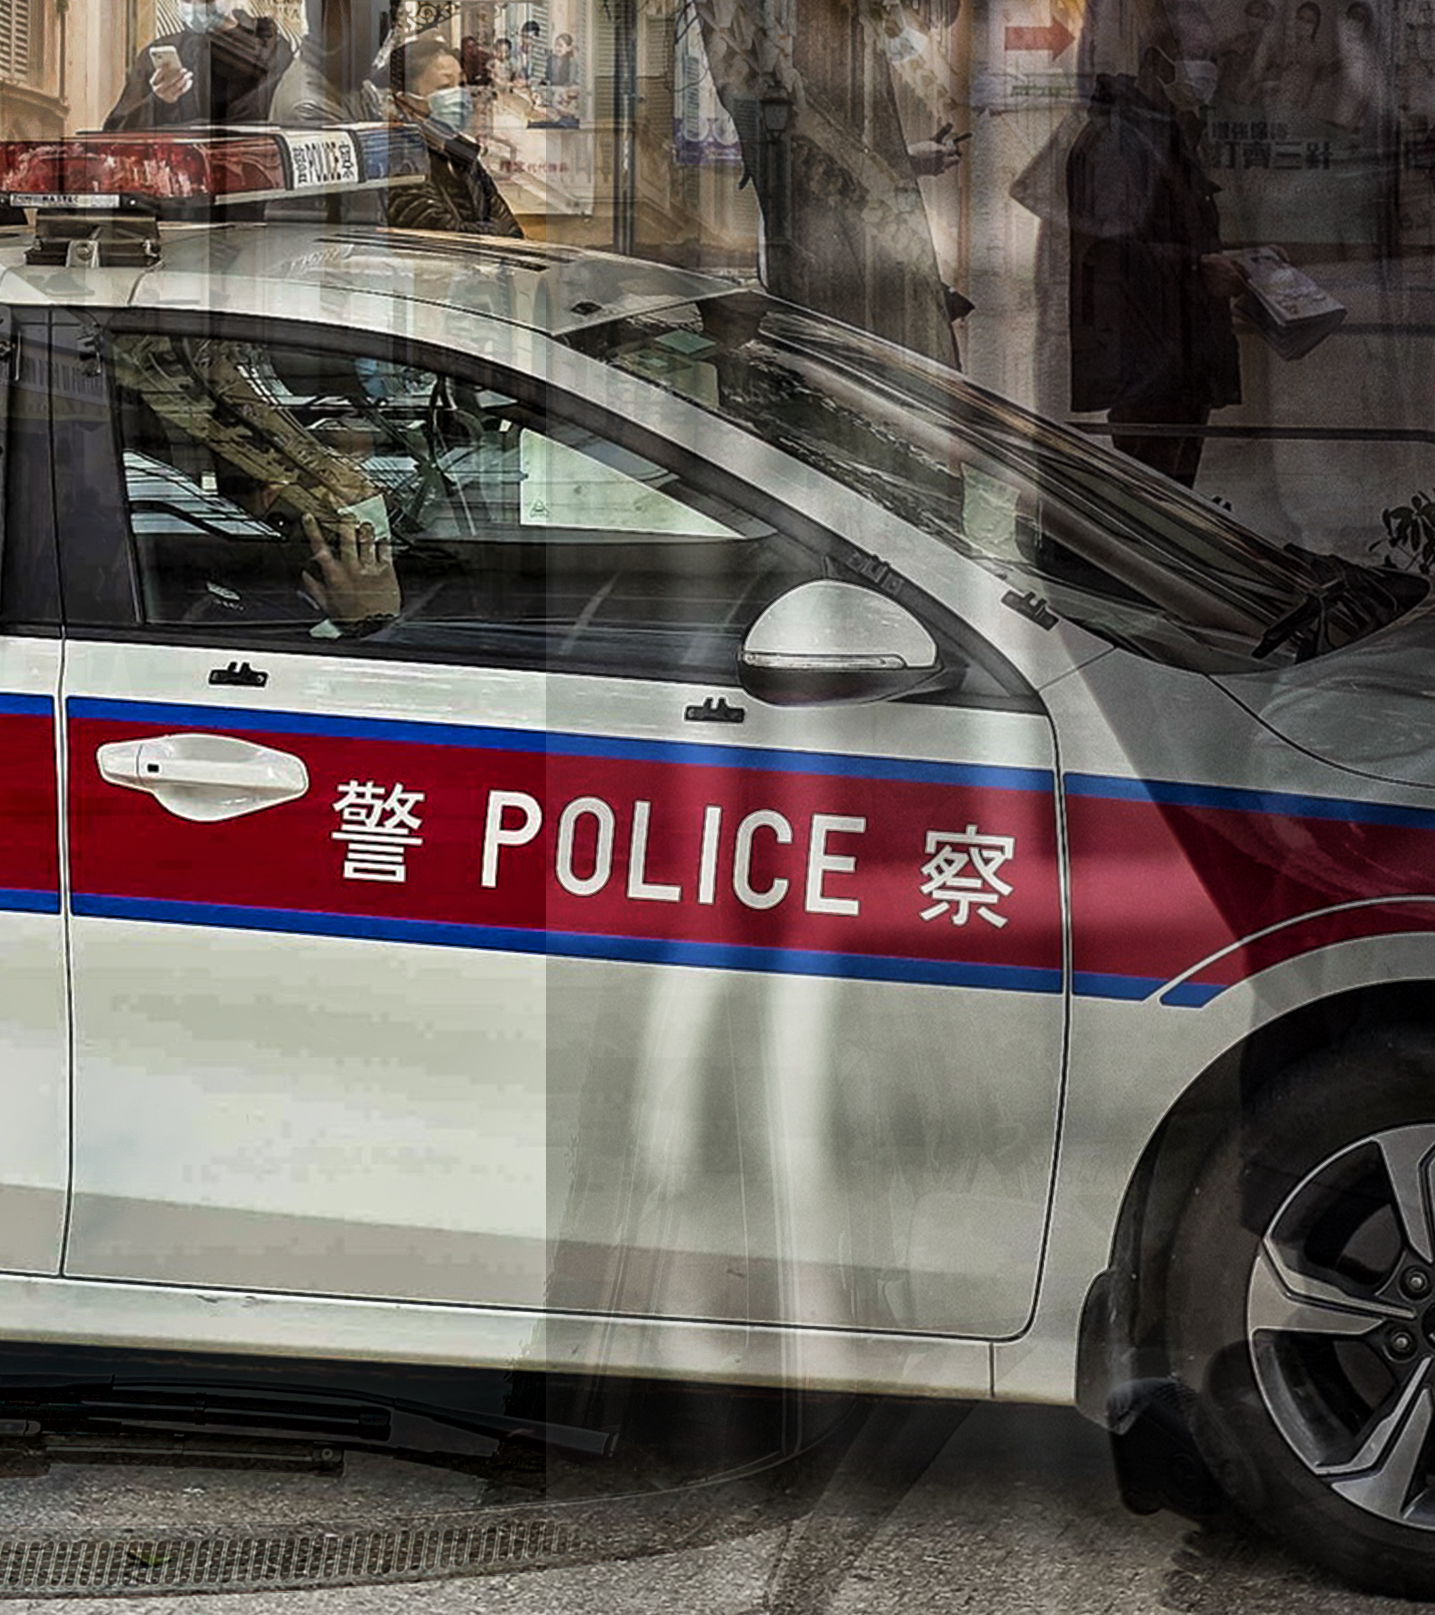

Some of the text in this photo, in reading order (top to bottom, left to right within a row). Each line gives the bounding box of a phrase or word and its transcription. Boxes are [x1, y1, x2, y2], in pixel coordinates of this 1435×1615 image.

[331, 780, 1016, 929] 警 POLICE 察
